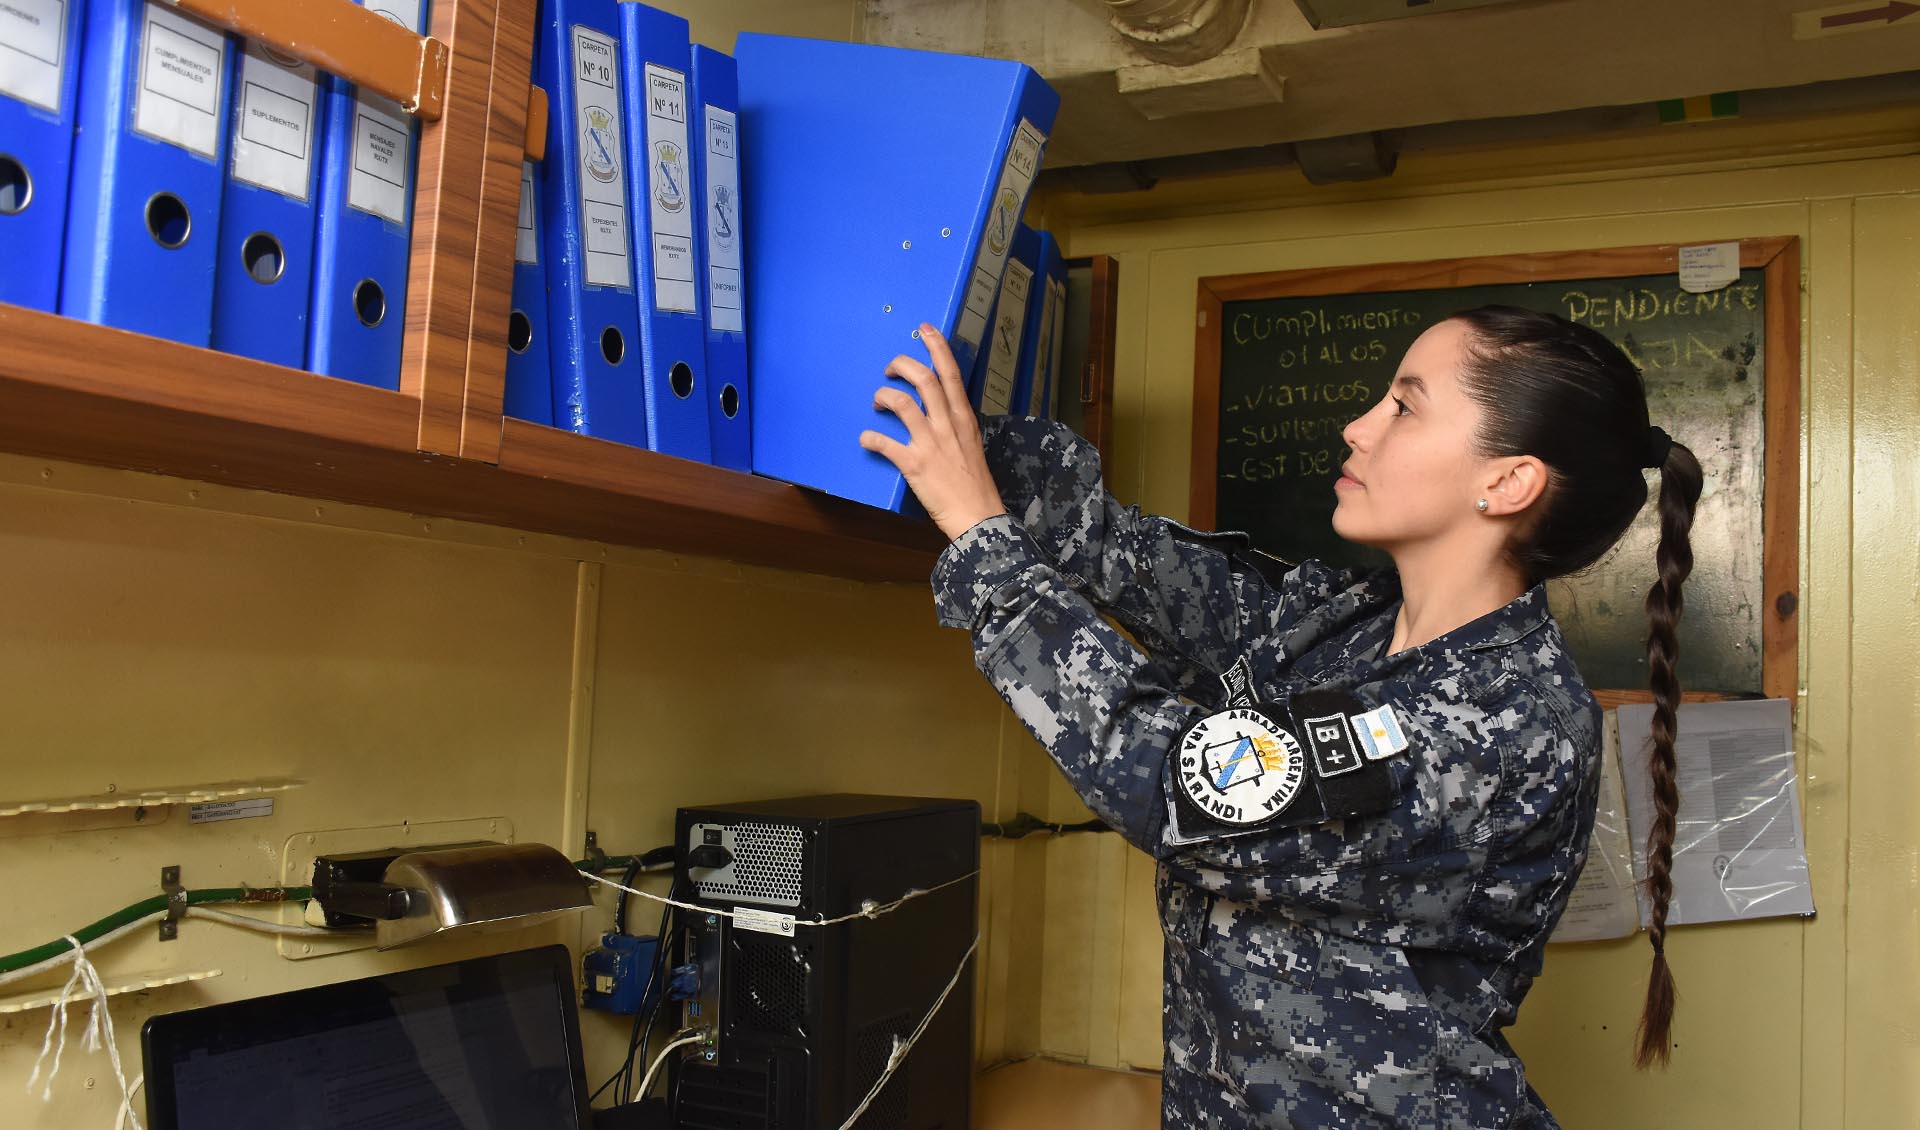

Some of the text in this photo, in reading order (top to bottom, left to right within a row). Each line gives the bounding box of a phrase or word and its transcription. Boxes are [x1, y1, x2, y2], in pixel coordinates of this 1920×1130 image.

[582, 41, 608, 56] CARPETA
[154, 46, 212, 76] CUMPLIMIENTOS
[160, 60, 204, 84] MENSUALES
[599, 65, 610, 82] 10
[653, 79, 680, 93] CARPETA
[252, 108, 300, 131] SUPLEMENTOS
[669, 101, 679, 116] 11
[1182, 722, 1242, 820] ARA SARANDI
[1229, 710, 1303, 811] ARMADA ARGENTINA
